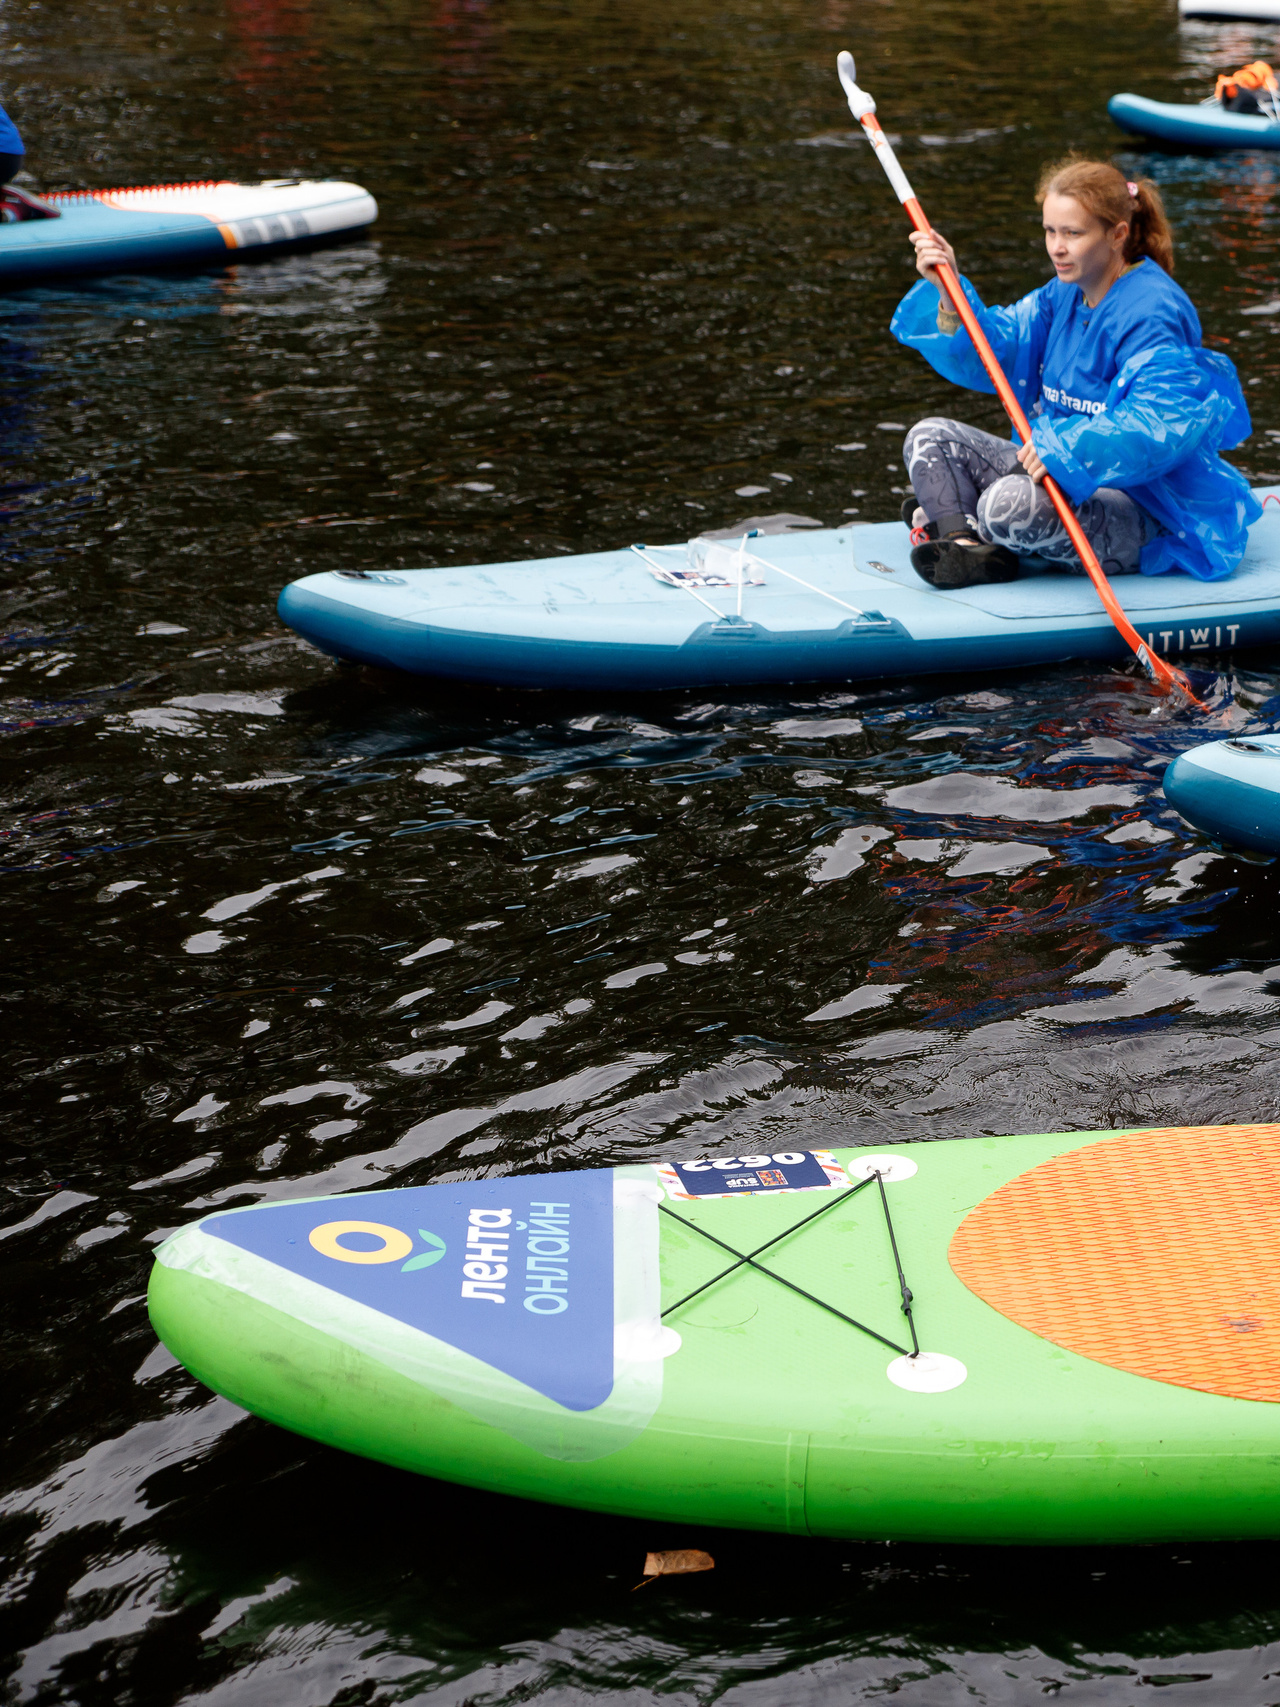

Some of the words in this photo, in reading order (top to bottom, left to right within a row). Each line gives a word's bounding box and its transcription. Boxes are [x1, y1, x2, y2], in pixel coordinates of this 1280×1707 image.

[1148, 624, 1240, 652] ITIWIT
[461, 1208, 513, 1304] лента
[515, 1202, 571, 1315] онлайн
